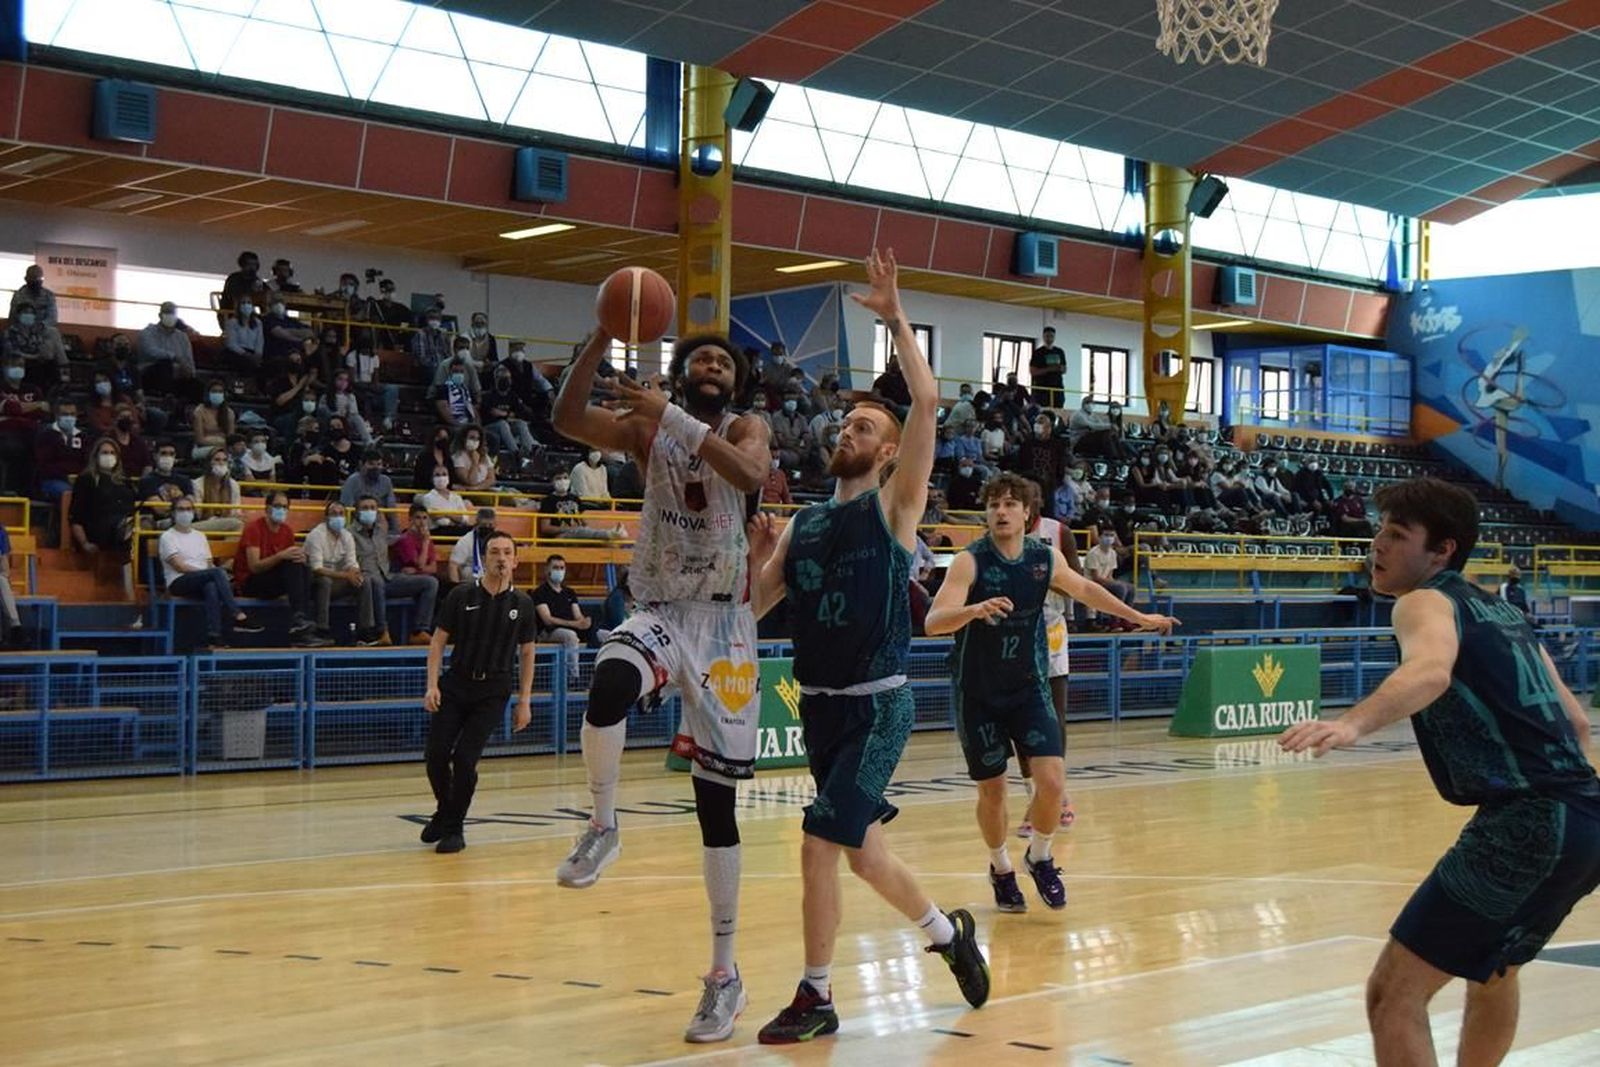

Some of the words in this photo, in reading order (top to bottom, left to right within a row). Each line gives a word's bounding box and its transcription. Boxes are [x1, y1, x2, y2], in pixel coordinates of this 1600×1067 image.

[658, 509, 736, 532] NNOVAHEF
[817, 591, 848, 629] 42
[1001, 634, 1021, 660] 12
[1511, 640, 1570, 722] 44
[1215, 702, 1258, 731] CAJA
[1259, 699, 1319, 729] RURAL
[977, 722, 998, 748] 12
